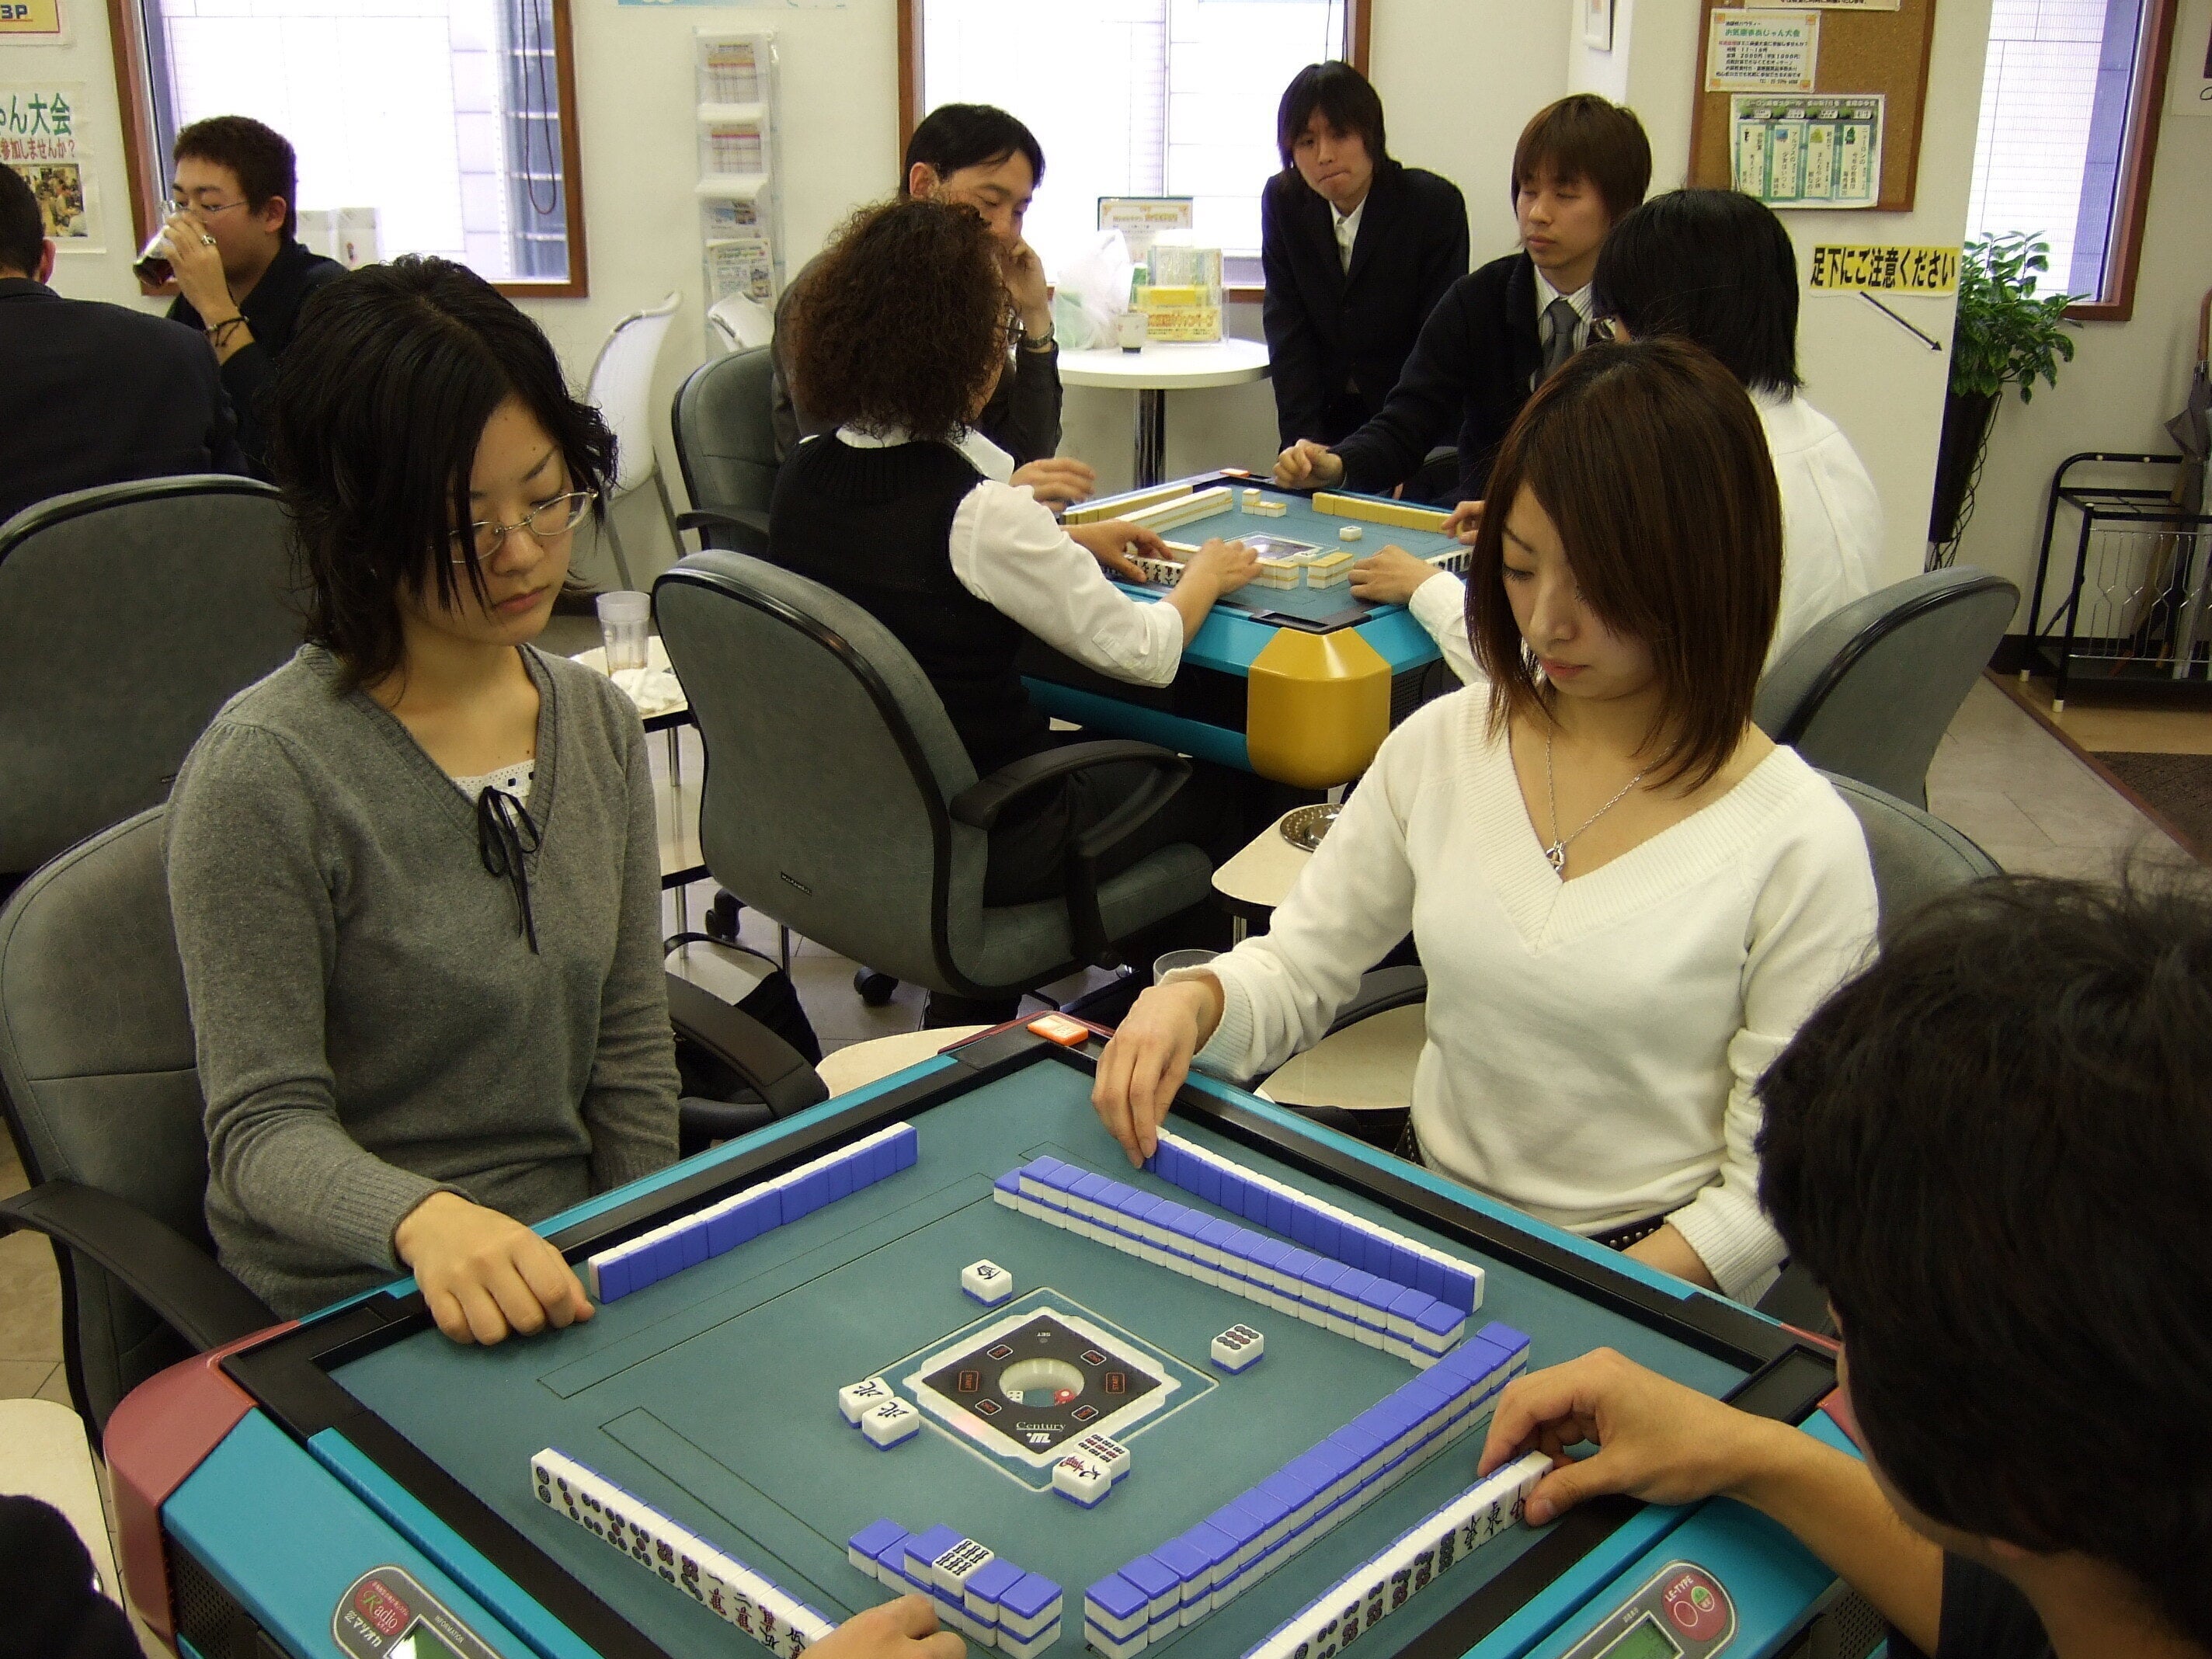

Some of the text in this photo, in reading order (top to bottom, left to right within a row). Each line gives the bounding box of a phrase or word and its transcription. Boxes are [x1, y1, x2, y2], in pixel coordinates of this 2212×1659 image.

[1810, 247, 1955, 288] 足下にご注意ください
[1016, 1421, 1066, 1432] Century
[1664, 1574, 1695, 1603] LE-TYPE
[360, 1590, 398, 1631] Radio
